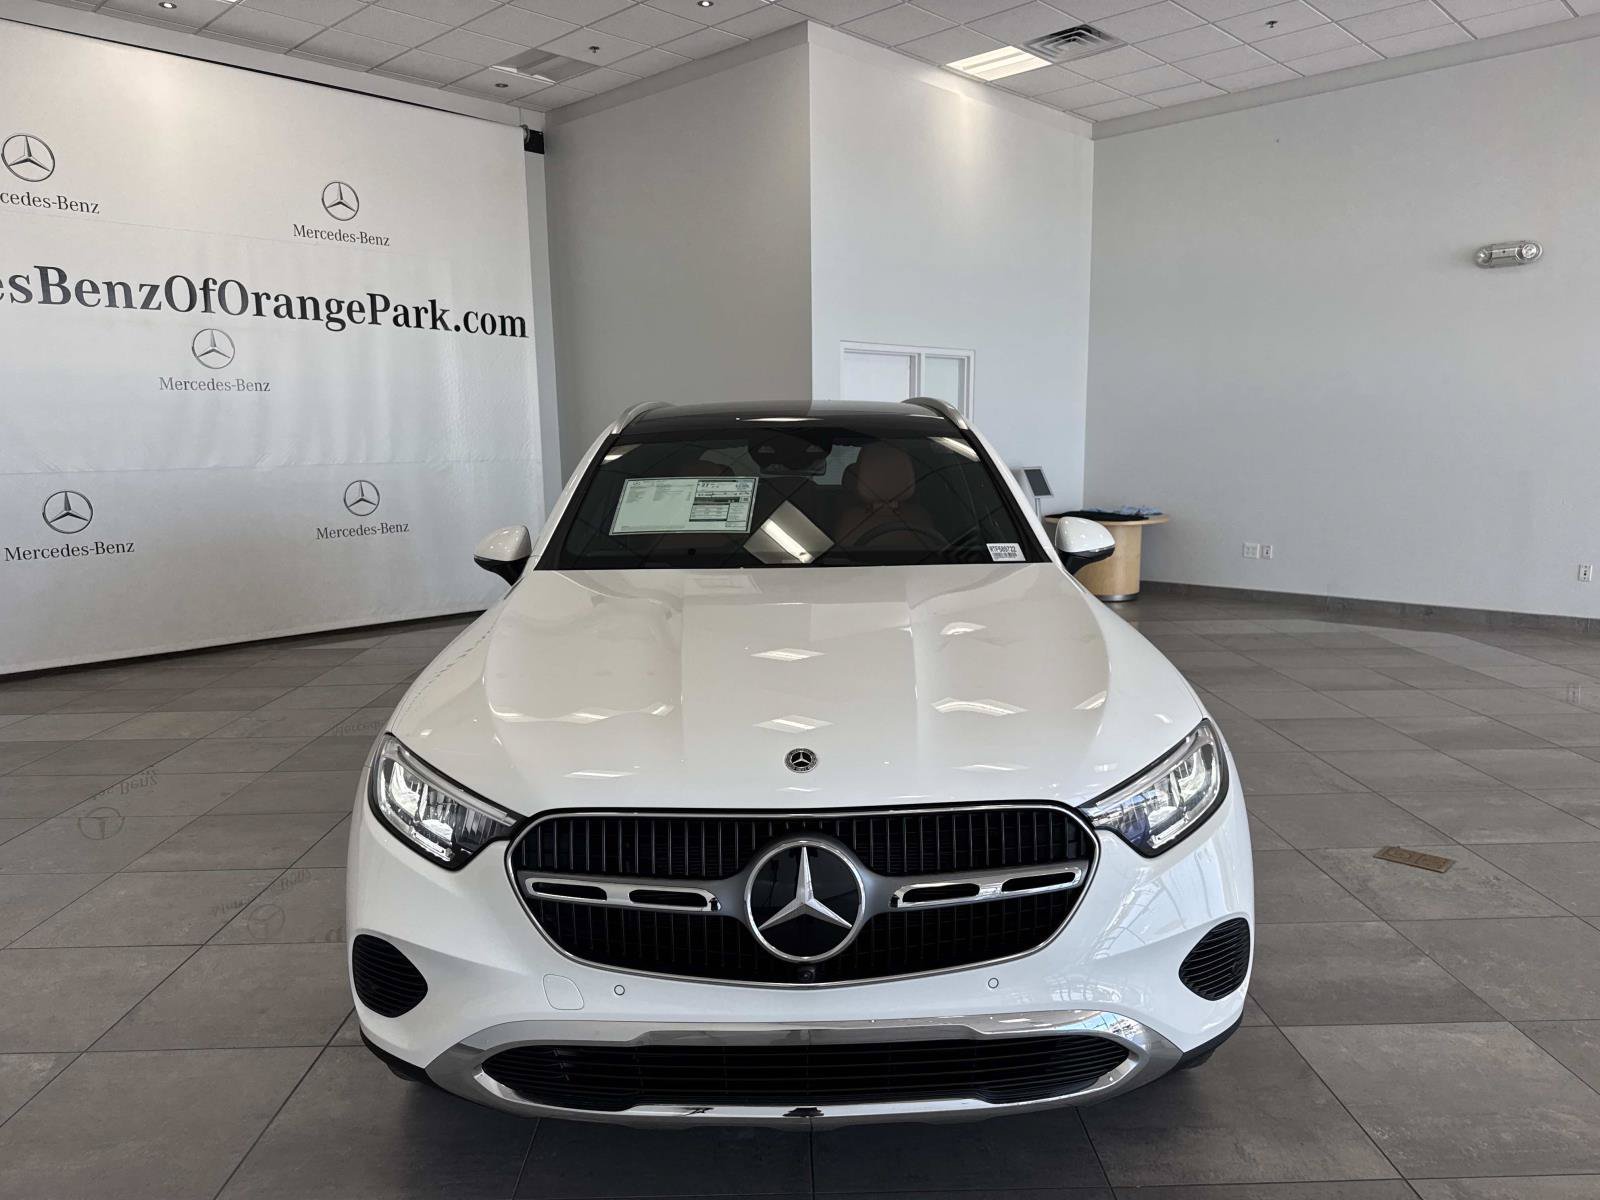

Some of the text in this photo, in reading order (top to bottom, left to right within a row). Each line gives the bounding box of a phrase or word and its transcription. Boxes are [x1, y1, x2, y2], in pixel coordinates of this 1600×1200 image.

[0, 191, 101, 216] cedes-Benz
[292, 223, 391, 247] Mercedes-Benz
[0, 265, 528, 338] sBenzOfOrangePark.com
[159, 376, 271, 392] Mercedes-Benz
[316, 522, 411, 541] Mercedes-Benz
[3, 541, 136, 562] Mercedes-Benz
